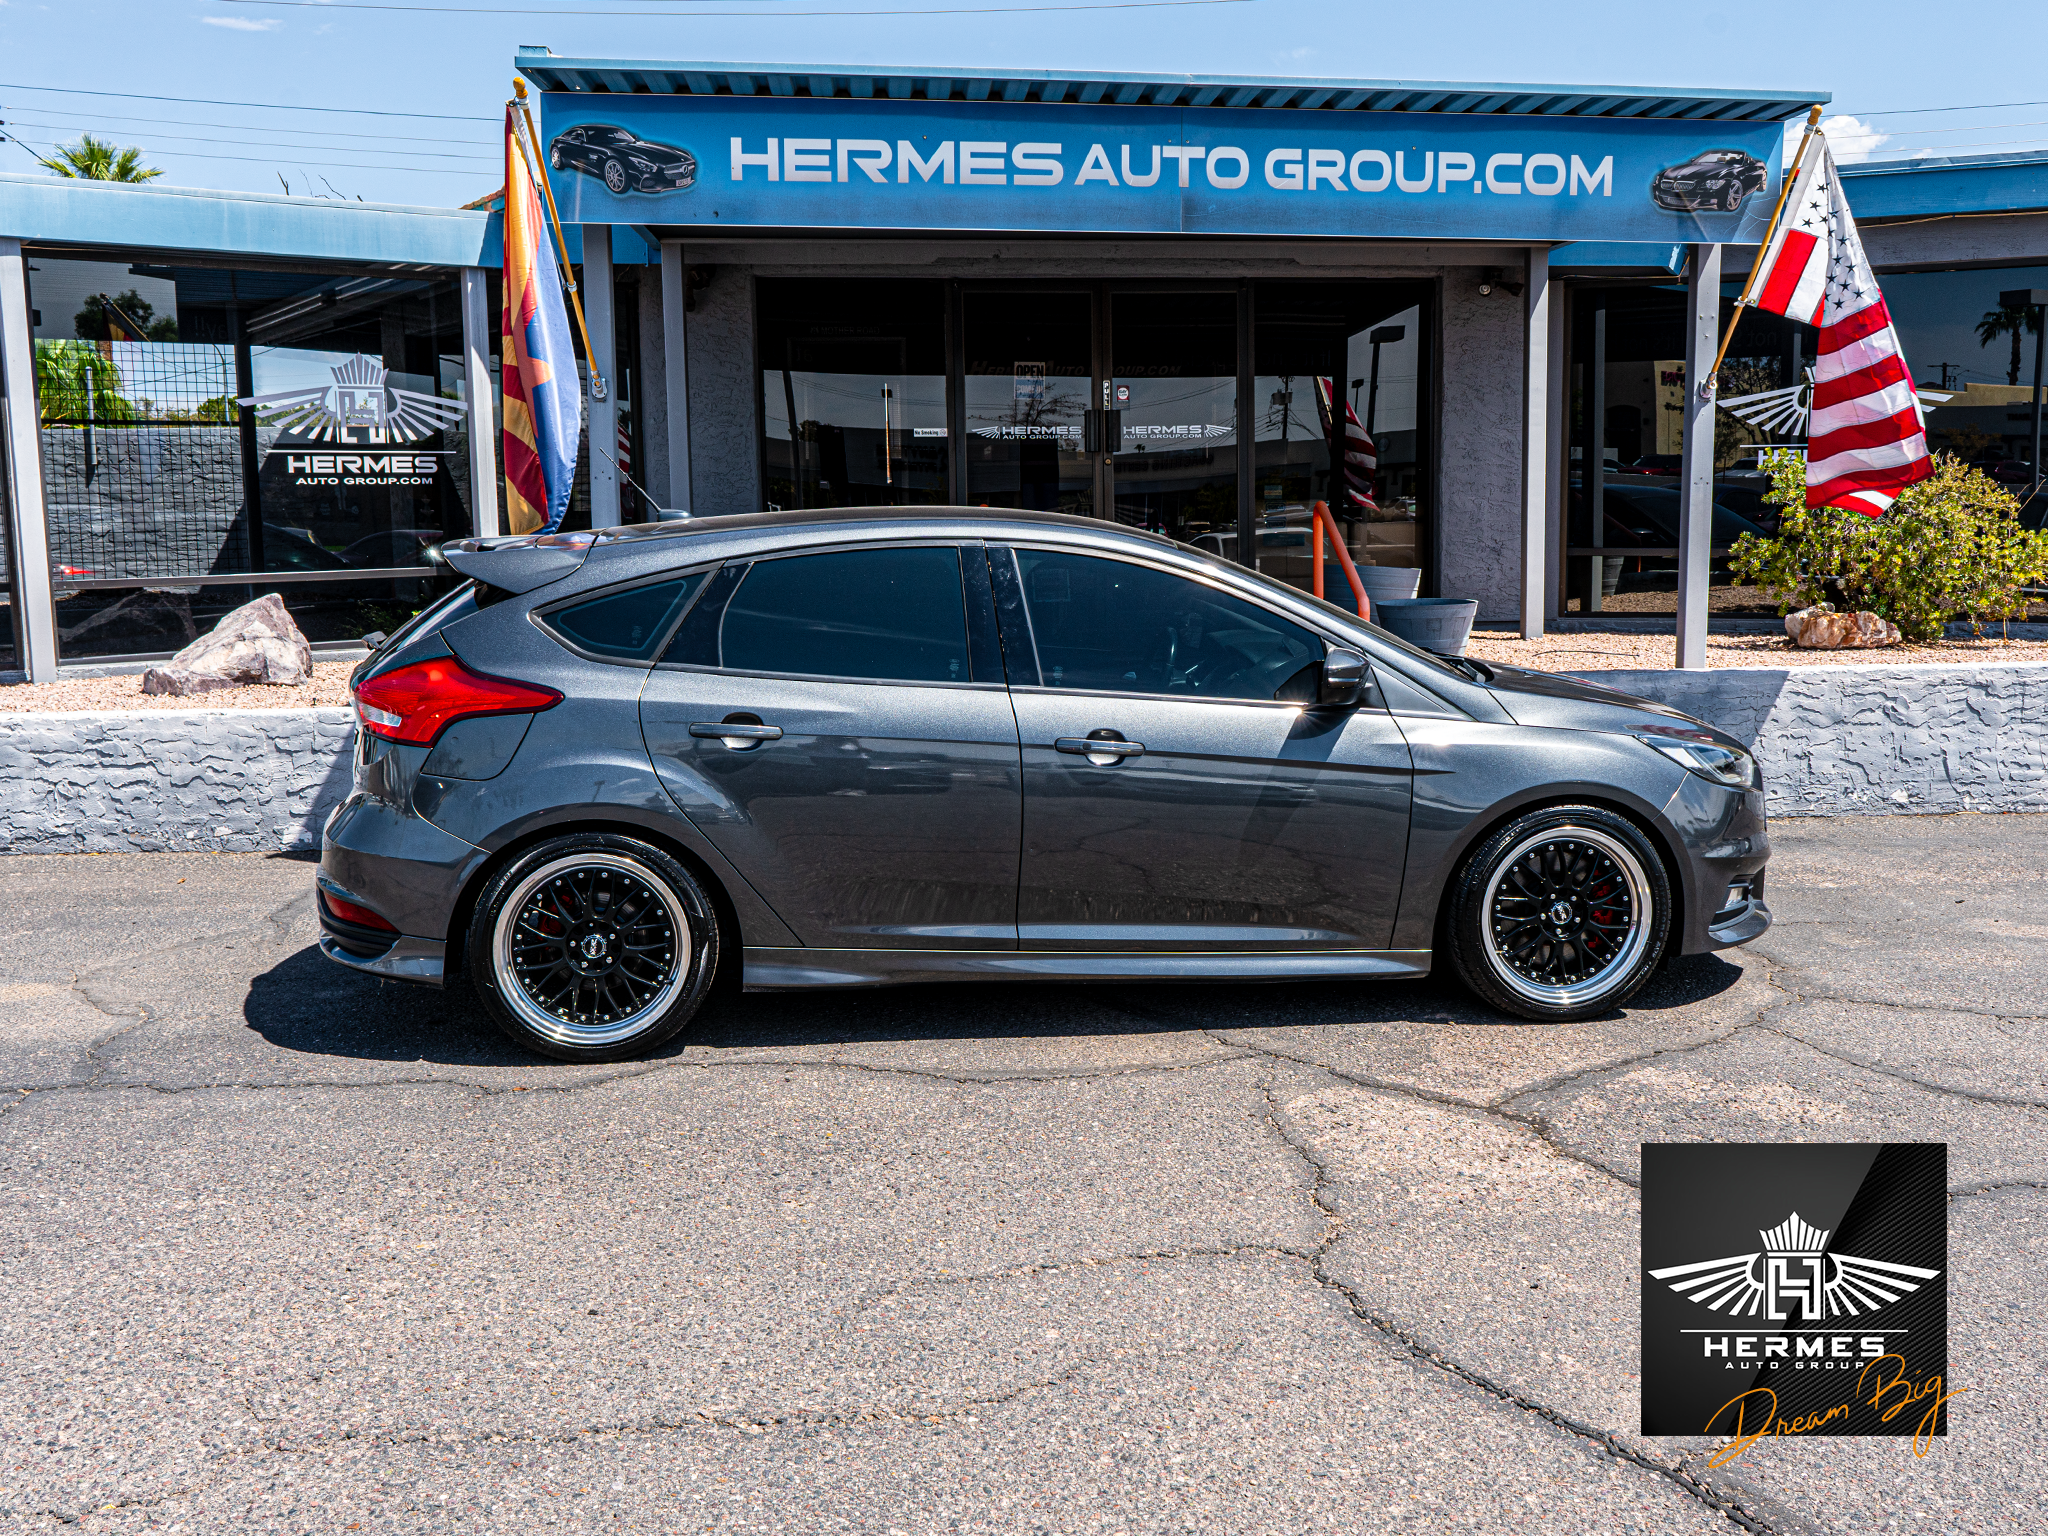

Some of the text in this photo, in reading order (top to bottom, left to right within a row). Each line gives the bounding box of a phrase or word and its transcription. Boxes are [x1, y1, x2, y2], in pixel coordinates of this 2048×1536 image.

[731, 137, 1614, 197] HERMES AUTO GROUP.COM
[1017, 364, 1044, 377] OPEN
[1002, 426, 1082, 435] HERMES
[1123, 425, 1202, 434] HERMES
[288, 455, 438, 474] HERMES
[295, 477, 433, 485] AUTO GROUP.COM
